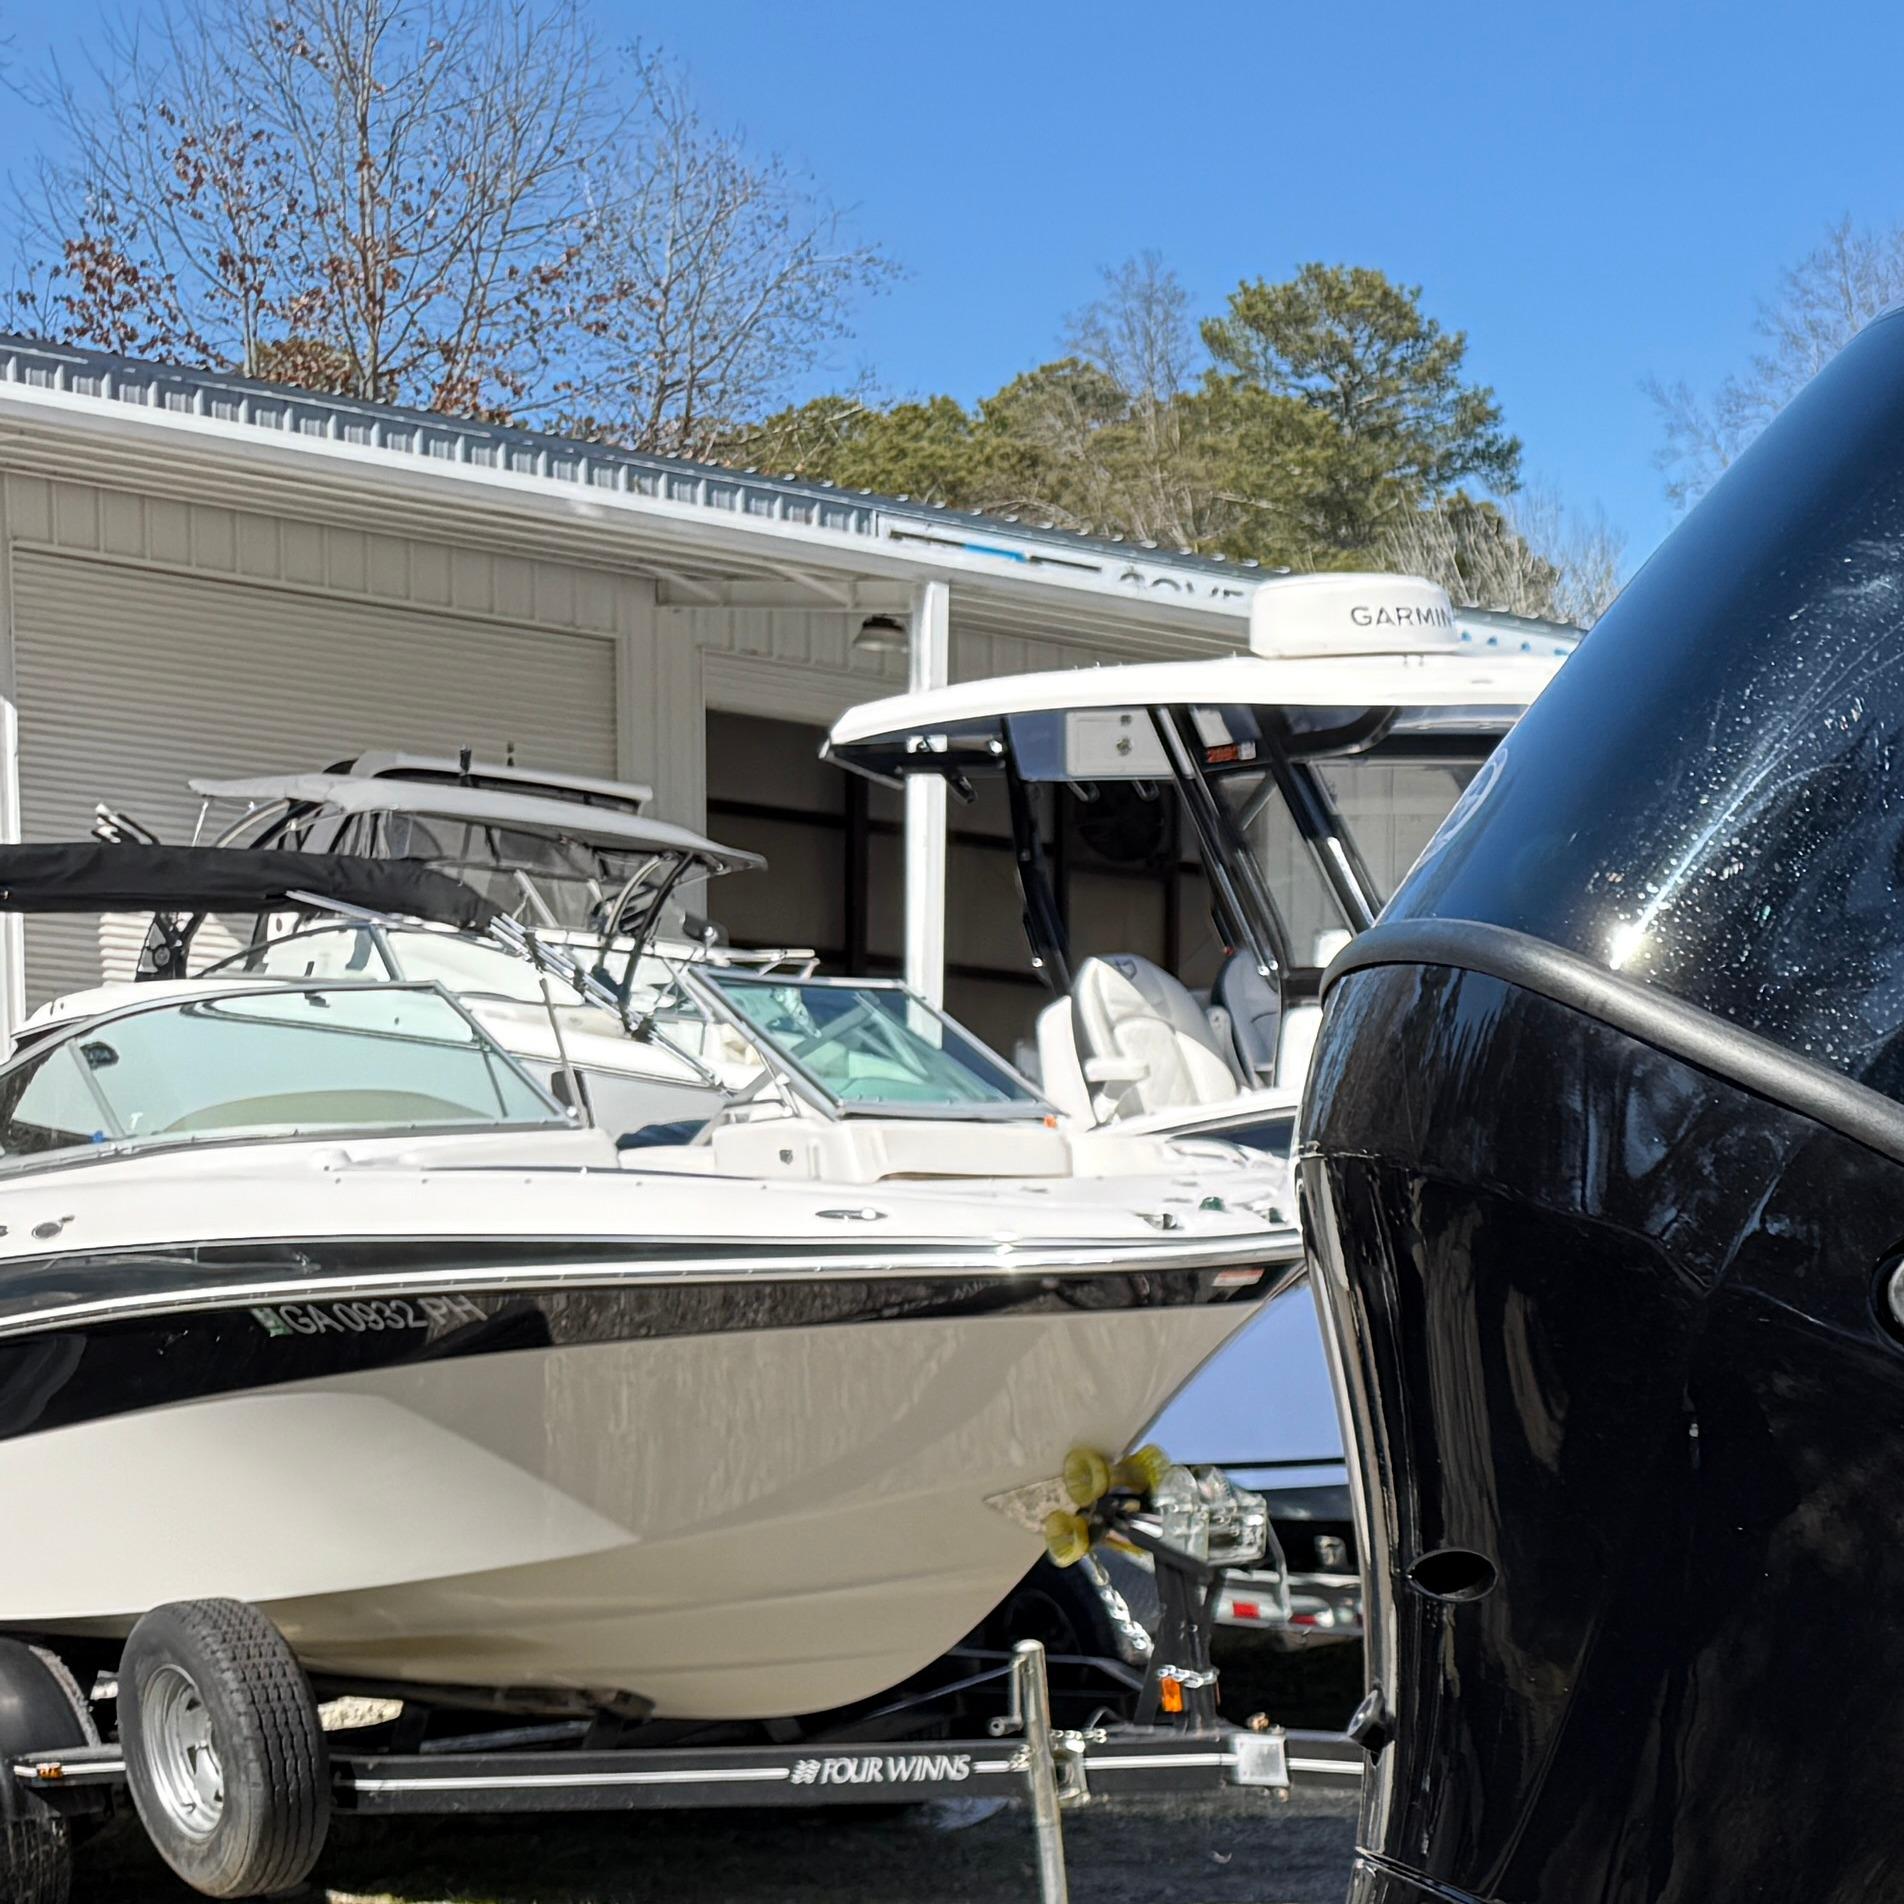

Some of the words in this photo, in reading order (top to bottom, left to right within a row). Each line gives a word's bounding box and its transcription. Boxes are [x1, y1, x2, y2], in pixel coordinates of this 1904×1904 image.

[1350, 605, 1453, 628] GARMIN
[820, 1756, 884, 1785] FOUR
[886, 1754, 971, 1783] WINNS
